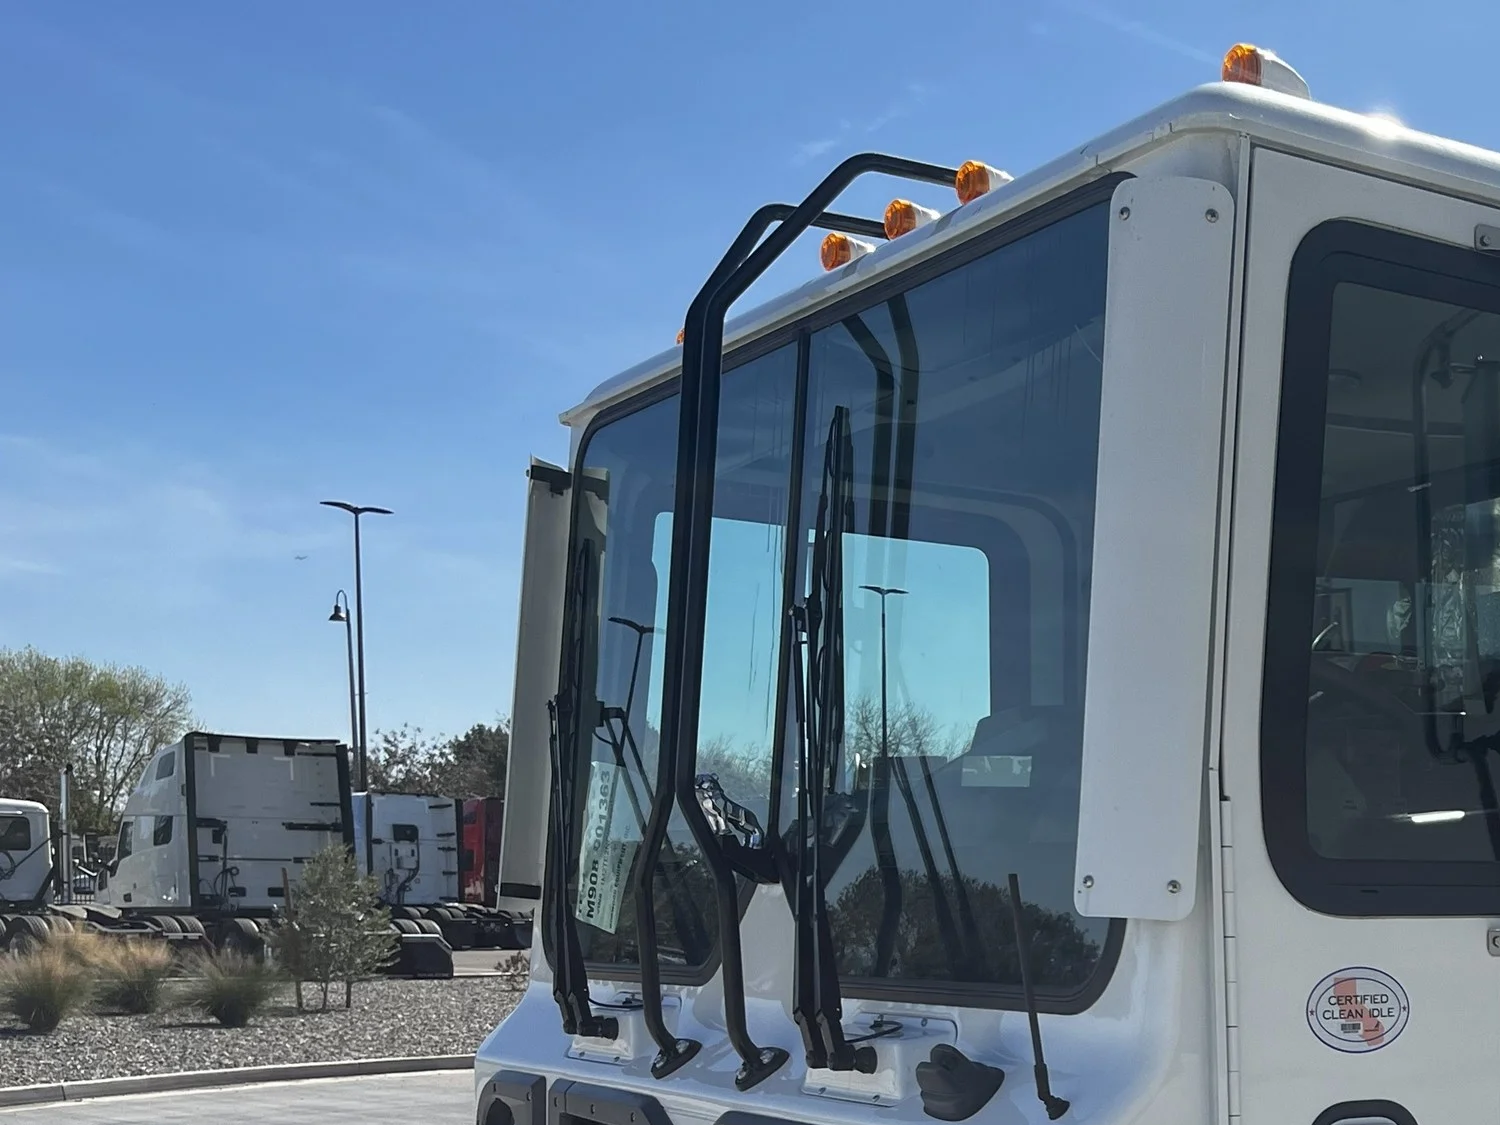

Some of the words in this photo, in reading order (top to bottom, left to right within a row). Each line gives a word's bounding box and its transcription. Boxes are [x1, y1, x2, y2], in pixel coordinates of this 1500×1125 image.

[1328, 993, 1389, 1006] CERTIFIED
[1322, 1008, 1363, 1020] CLEAN
[1368, 1007, 1395, 1018] IDLE
